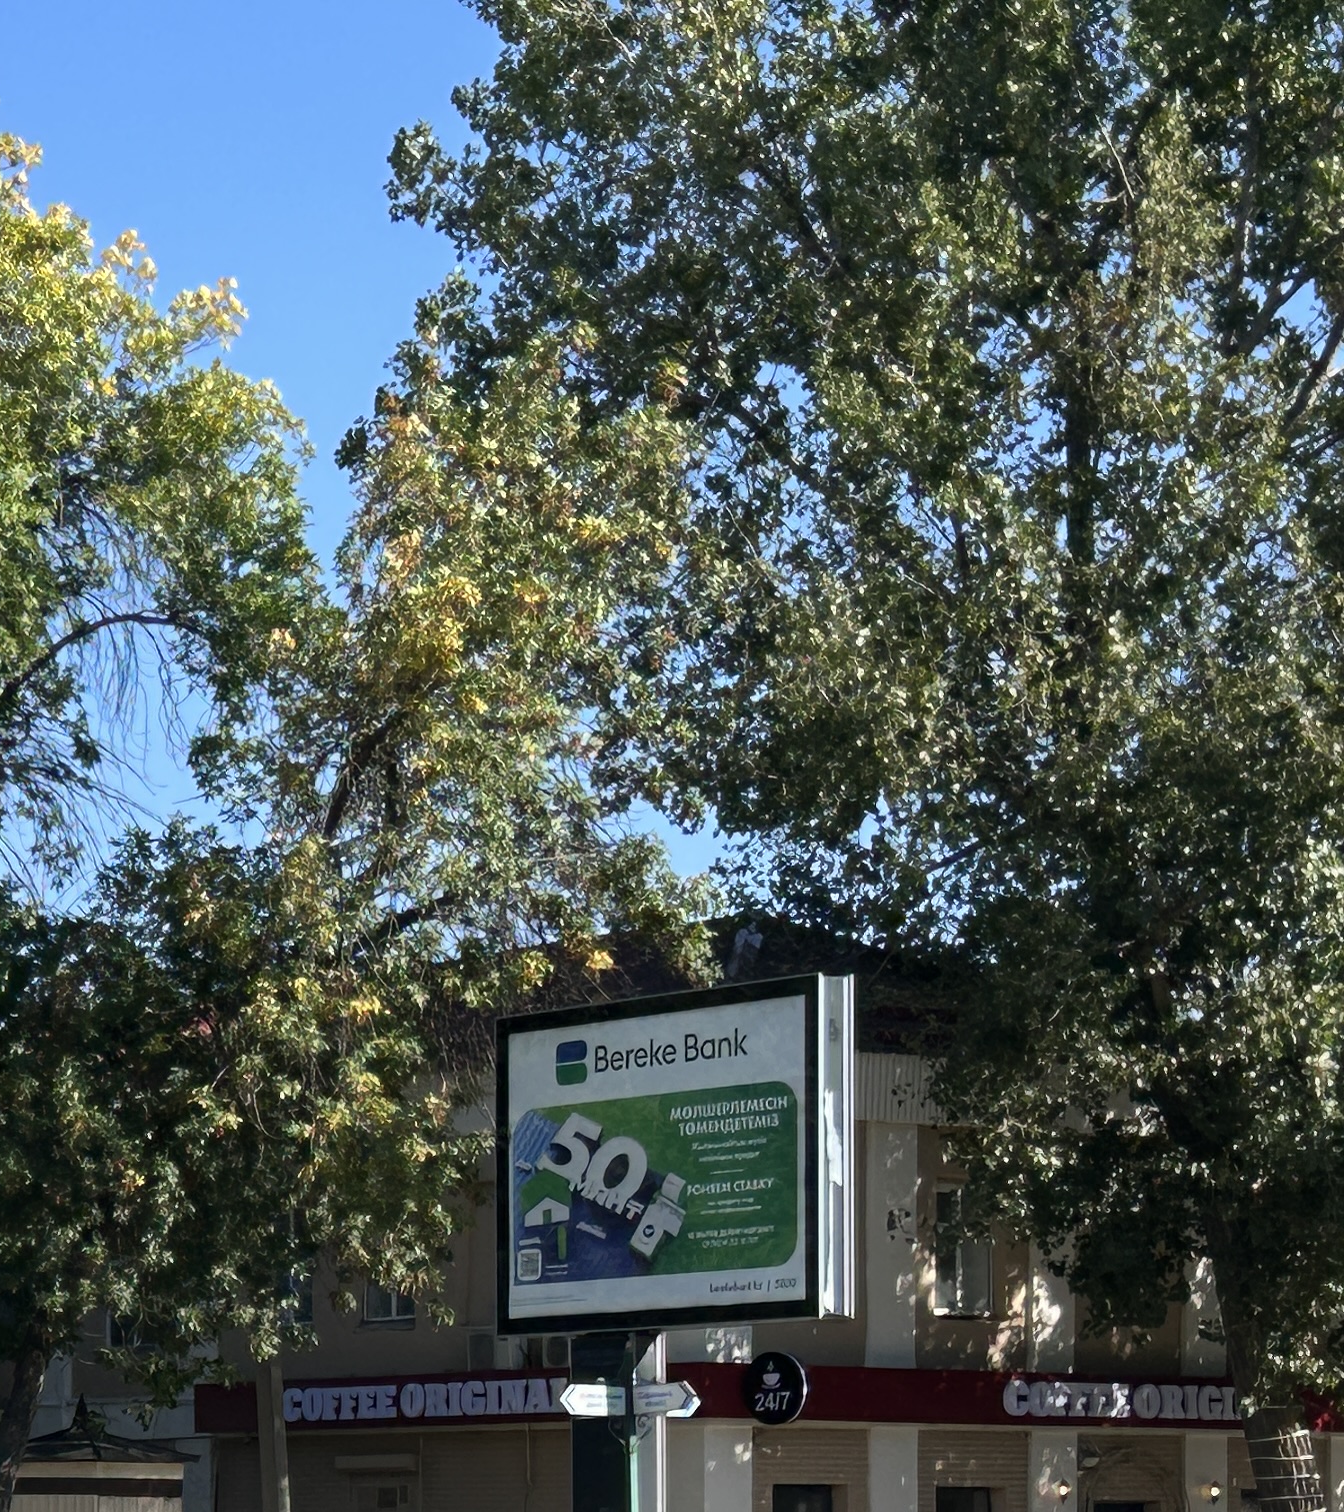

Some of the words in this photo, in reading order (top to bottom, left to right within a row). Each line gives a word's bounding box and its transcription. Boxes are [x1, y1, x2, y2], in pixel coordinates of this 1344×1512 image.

[594, 1038, 677, 1073] Bereke
[684, 1027, 748, 1062] Bank
[536, 1112, 648, 1201] 50
[282, 1385, 397, 1422] COFFEE
[754, 1391, 791, 1412] 24/7
[1002, 1379, 1131, 1419] COFFEE
